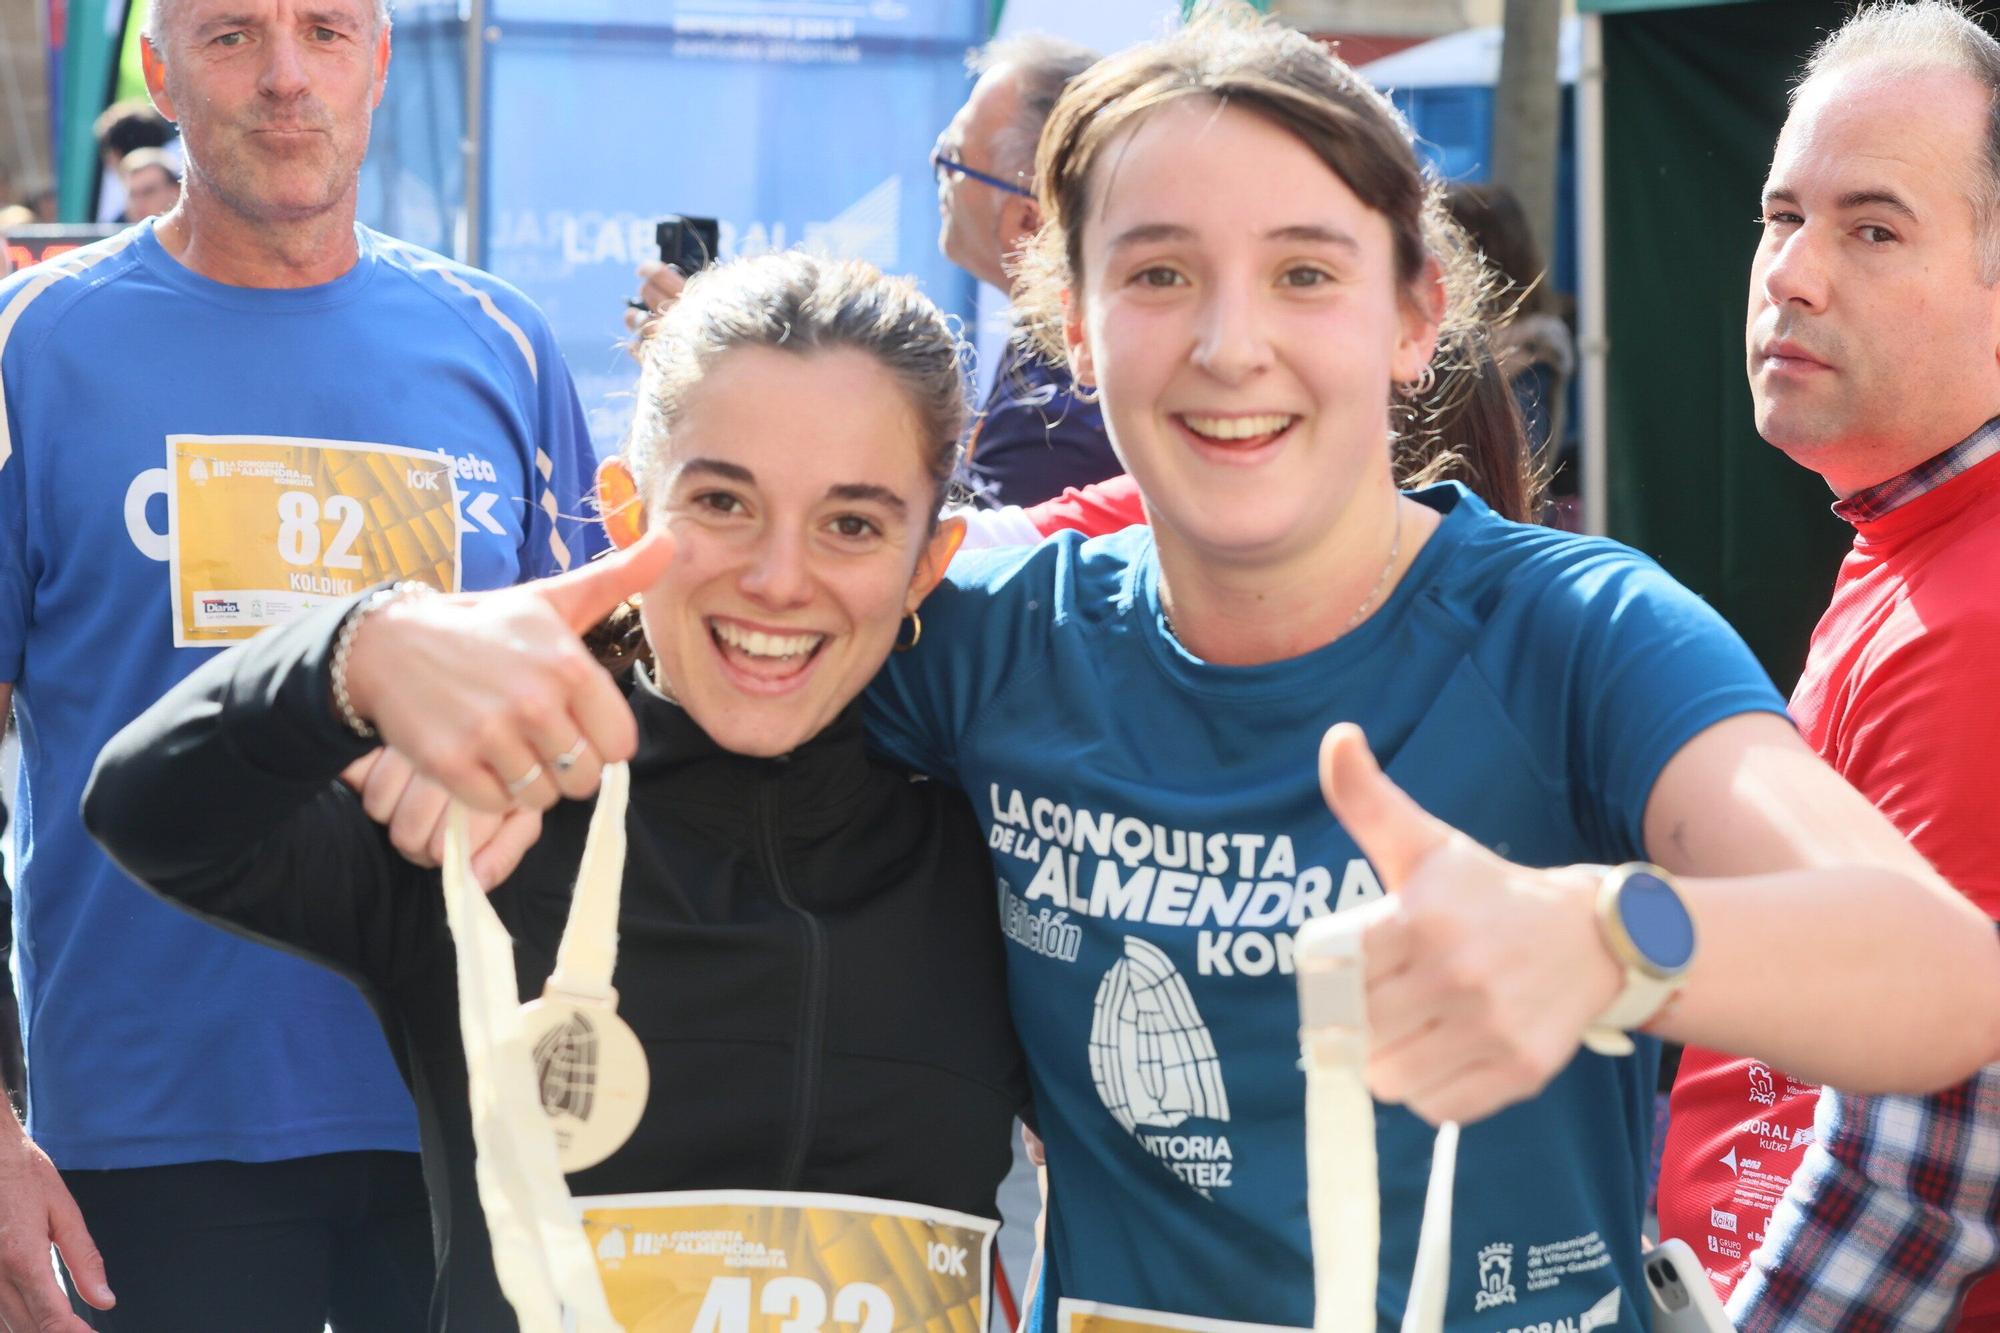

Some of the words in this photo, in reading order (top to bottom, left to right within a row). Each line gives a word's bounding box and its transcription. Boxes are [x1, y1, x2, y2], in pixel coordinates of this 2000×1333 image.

[561, 217, 786, 264] LABRAL
[278, 490, 364, 570] 82
[988, 823, 1015, 855] DE
[1014, 834, 1041, 863] LA
[990, 783, 1031, 831] LA
[1031, 797, 1296, 879] CONQUISTA
[1025, 845, 1385, 929] ALMENDRA
[1759, 1138, 1788, 1153] kutxa
[1163, 1161, 1233, 1187] STEIZ
[1713, 1212, 1736, 1229] Kaiku
[927, 1240, 967, 1278] 10K
[1719, 1238, 1742, 1250] GRUPO
[691, 1276, 896, 1333] 432
